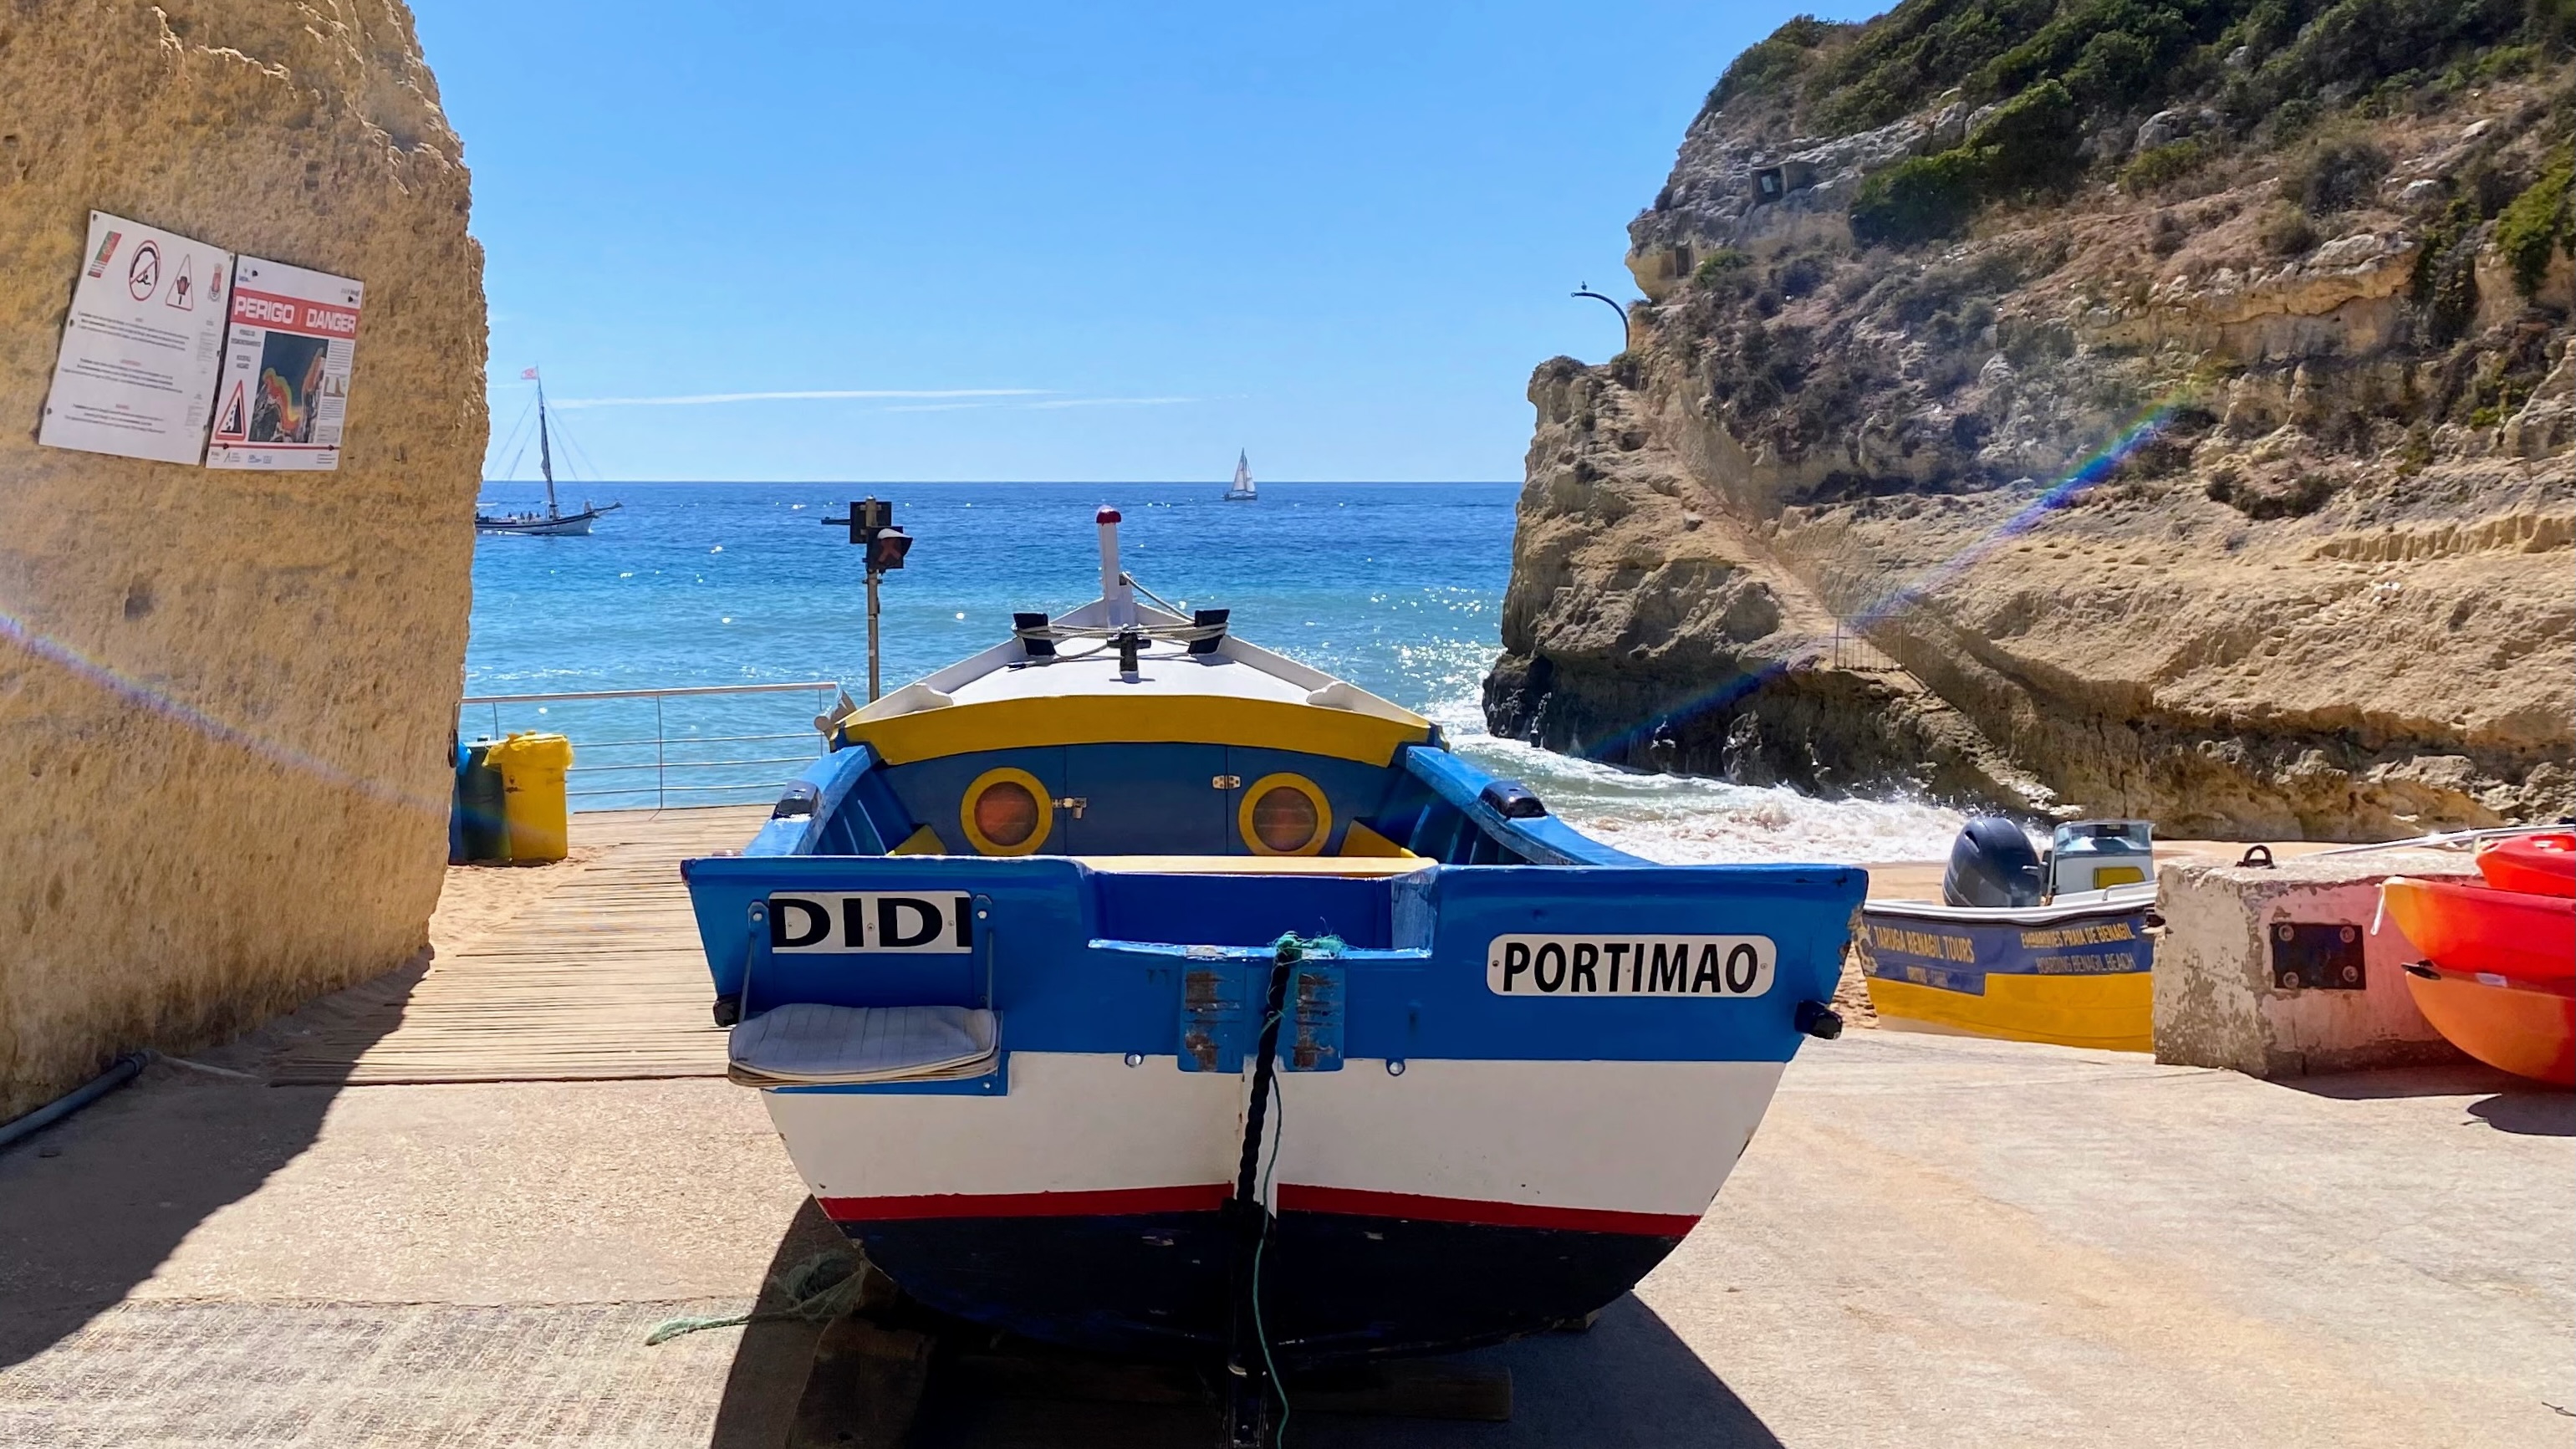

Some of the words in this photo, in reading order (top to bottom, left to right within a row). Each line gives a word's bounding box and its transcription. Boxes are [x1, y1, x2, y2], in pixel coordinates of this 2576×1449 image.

[233, 295, 295, 324] PERIGO
[306, 308, 357, 334] DANGER
[768, 897, 972, 947] DIDI
[2061, 928, 2088, 946] PRAIA
[2084, 926, 2100, 945] DE
[2095, 921, 2137, 942] BENAGIL
[1873, 925, 1907, 953] TARUGA
[1906, 930, 1945, 959] BENAGIL
[1942, 935, 1975, 964] TOURS
[2035, 955, 2073, 974] BOARDING
[2070, 953, 2107, 972] BENAGIL
[2104, 952, 2137, 971] BEACH
[1502, 942, 1758, 993] PORTIMAO
